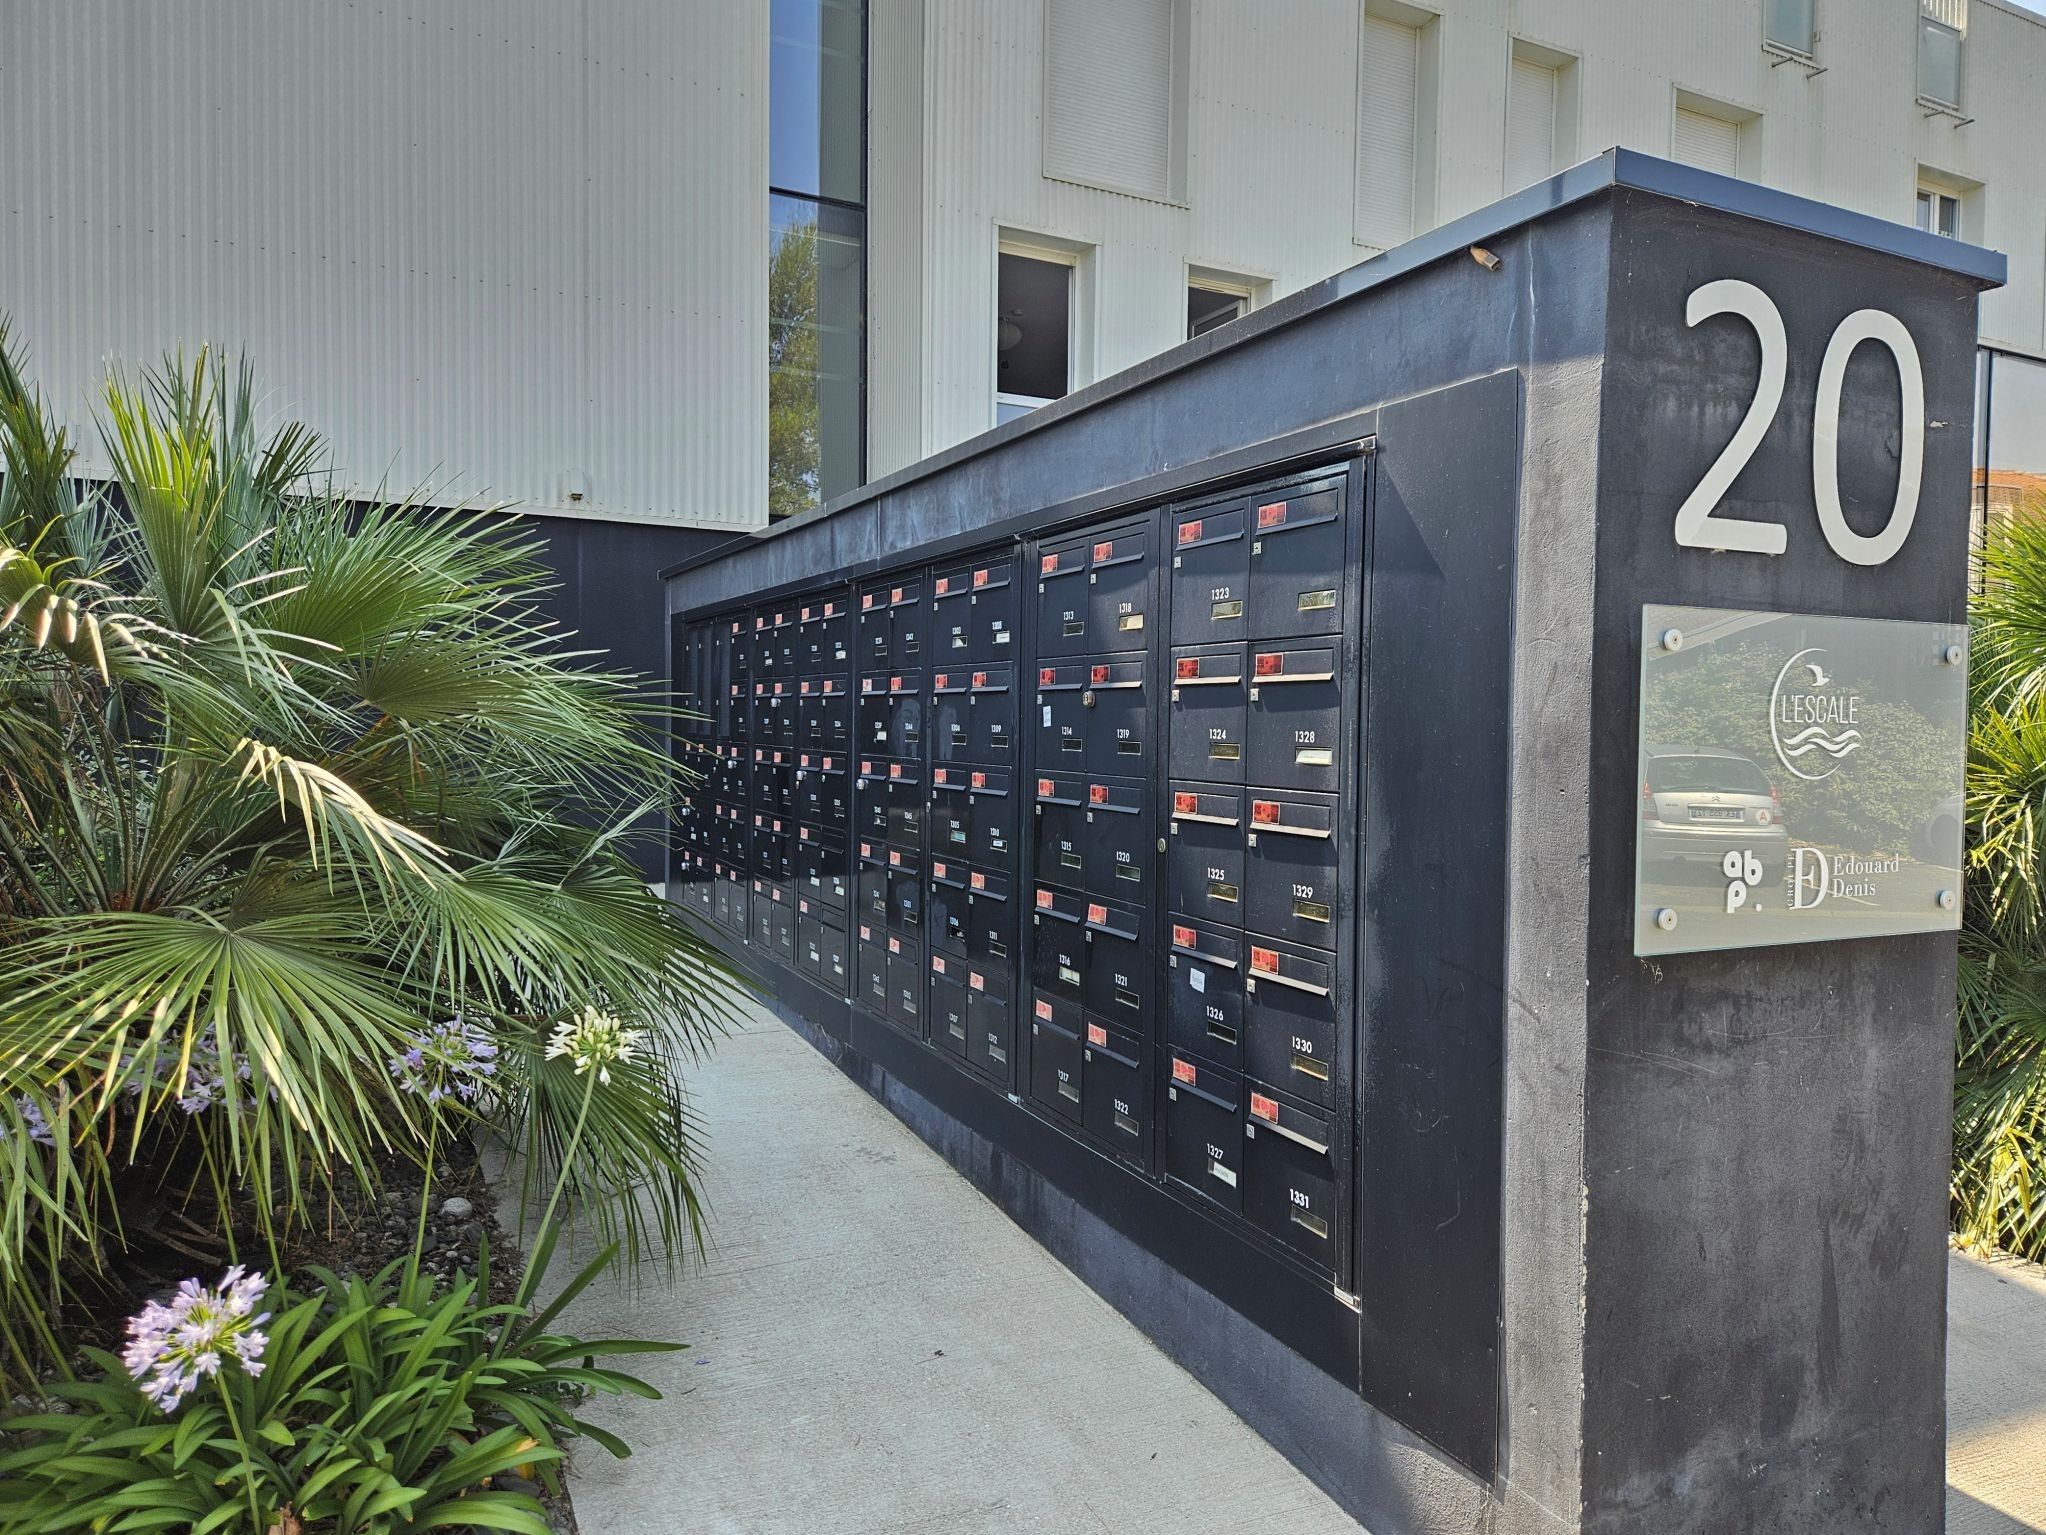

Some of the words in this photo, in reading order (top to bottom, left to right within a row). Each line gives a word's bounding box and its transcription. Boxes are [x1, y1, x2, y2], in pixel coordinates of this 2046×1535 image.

[1675, 279, 1924, 566] 20
[1211, 587, 1230, 600] 1323
[1119, 602, 1132, 614] 1318
[1063, 610, 1074, 621] 1313
[1782, 694, 1859, 724] L'ESCALE
[1061, 726, 1072, 736] 1314
[1117, 728, 1130, 739] 1319
[1209, 728, 1227, 740] 1324
[1295, 730, 1315, 743] 1328
[1061, 840, 1072, 852] 1315
[1116, 851, 1130, 863] 1320
[1832, 854, 1899, 876] Edouard
[1207, 867, 1225, 881] 1325
[1292, 884, 1313, 899] 1329
[1832, 878, 1876, 898] Denis
[1059, 953, 1071, 966] 1316
[1114, 973, 1128, 987] 1321
[1206, 1005, 1224, 1021] 1326
[1292, 1036, 1312, 1054] 1330
[1057, 1069, 1069, 1082] 1317
[1114, 1098, 1129, 1115] 1322
[1206, 1143, 1224, 1160] 1327
[1289, 1188, 1309, 1209] 1331
